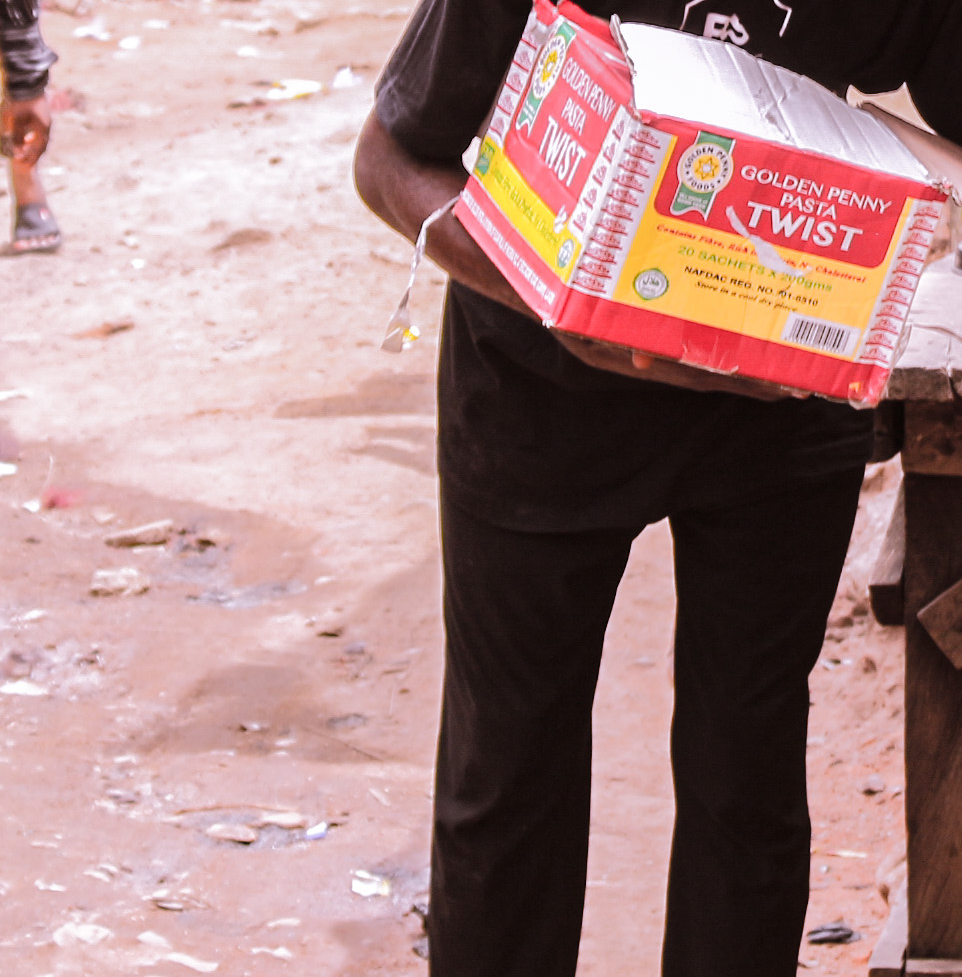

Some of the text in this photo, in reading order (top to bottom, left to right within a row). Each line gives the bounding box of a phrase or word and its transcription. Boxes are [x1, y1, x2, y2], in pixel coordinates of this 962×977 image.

[562, 57, 594, 101] GOLDEN
[587, 84, 617, 122] PENNY
[561, 97, 587, 136] PASTA
[538, 115, 587, 187] TWIST
[685, 146, 714, 169] GOLDEN
[741, 164, 892, 214] GOLDEN PENNY
[780, 192, 837, 220] PASTA
[747, 200, 863, 251] TWIST
[678, 245, 695, 257] 20
[698, 251, 765, 276] SACHETS
[684, 265, 727, 283] NAFDAC
